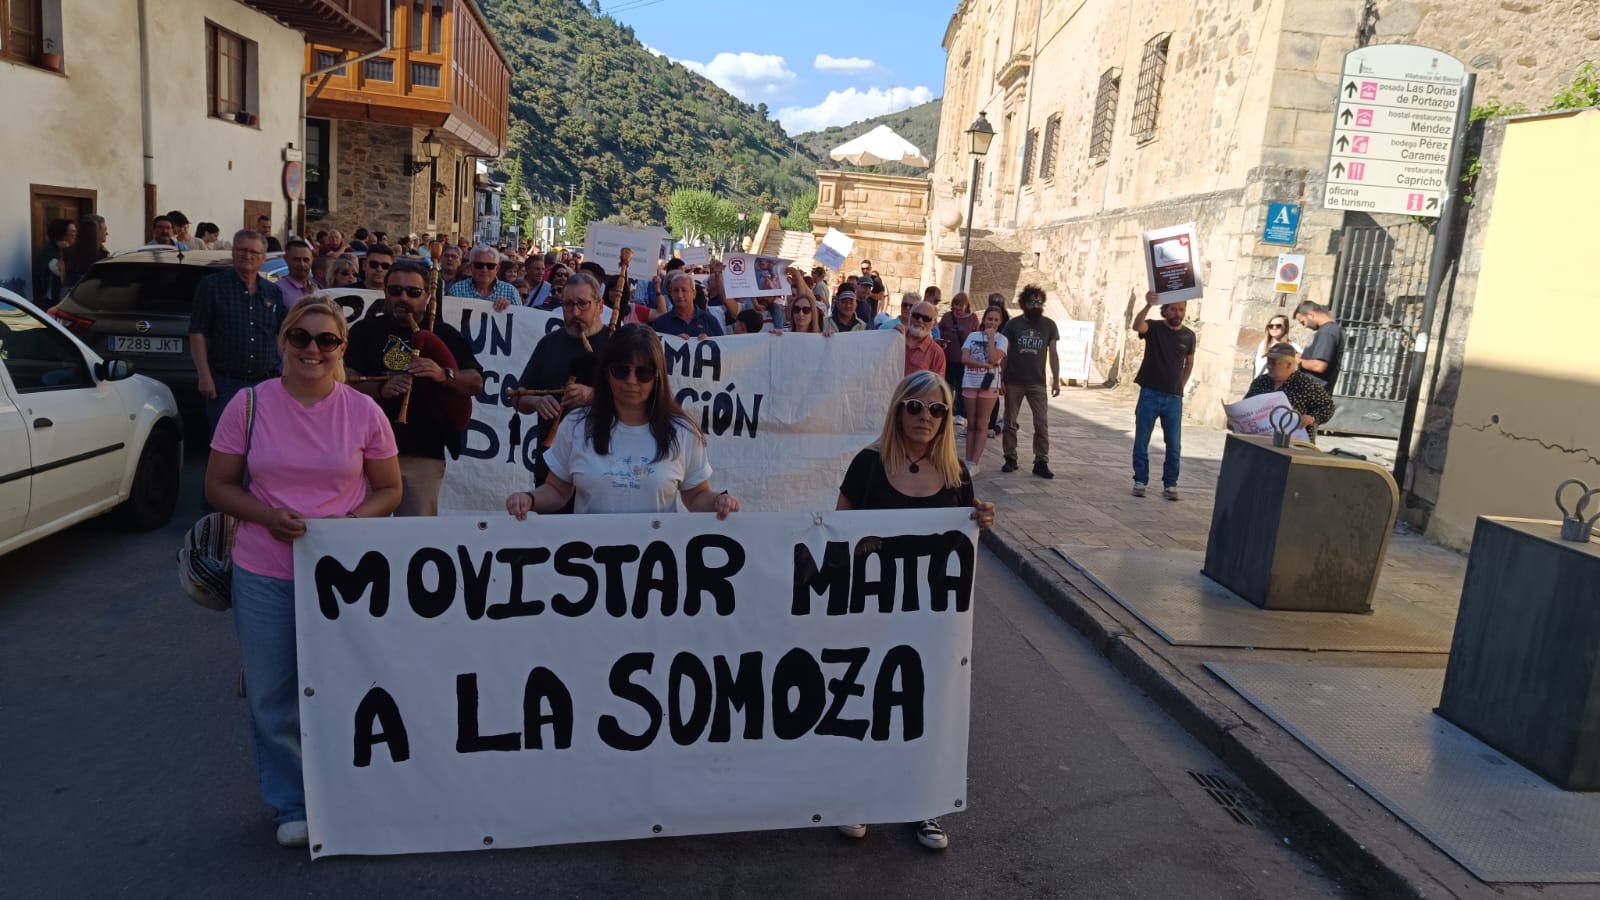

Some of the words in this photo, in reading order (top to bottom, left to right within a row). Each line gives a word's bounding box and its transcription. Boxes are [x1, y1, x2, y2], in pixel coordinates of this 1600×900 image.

[1379, 83, 1405, 92] posada
[1406, 83, 1424, 93] Las
[1426, 84, 1457, 96] Doñas
[1396, 94, 1409, 104] de
[1411, 95, 1455, 109] Portazgo
[1388, 111, 1453, 122] hostal-restaurante
[1410, 121, 1451, 134] Méndez
[1391, 138, 1417, 149] bodega
[1419, 138, 1448, 150] Pérez
[1401, 149, 1446, 162] Caramés
[1404, 166, 1444, 175] restaurante
[1396, 174, 1442, 187] Capricho
[1328, 186, 1359, 196] oficina
[1328, 197, 1339, 205] de
[1341, 198, 1376, 208] turismo
[1273, 206, 1290, 224] A
[461, 309, 513, 356] UN
[118, 338, 151, 350] 7289
[156, 339, 180, 351] JKT
[314, 533, 746, 620] MOVISTAR
[792, 529, 974, 615] MATA
[353, 685, 410, 768] A
[456, 666, 574, 753] LA
[598, 644, 925, 752] SOMOZA
